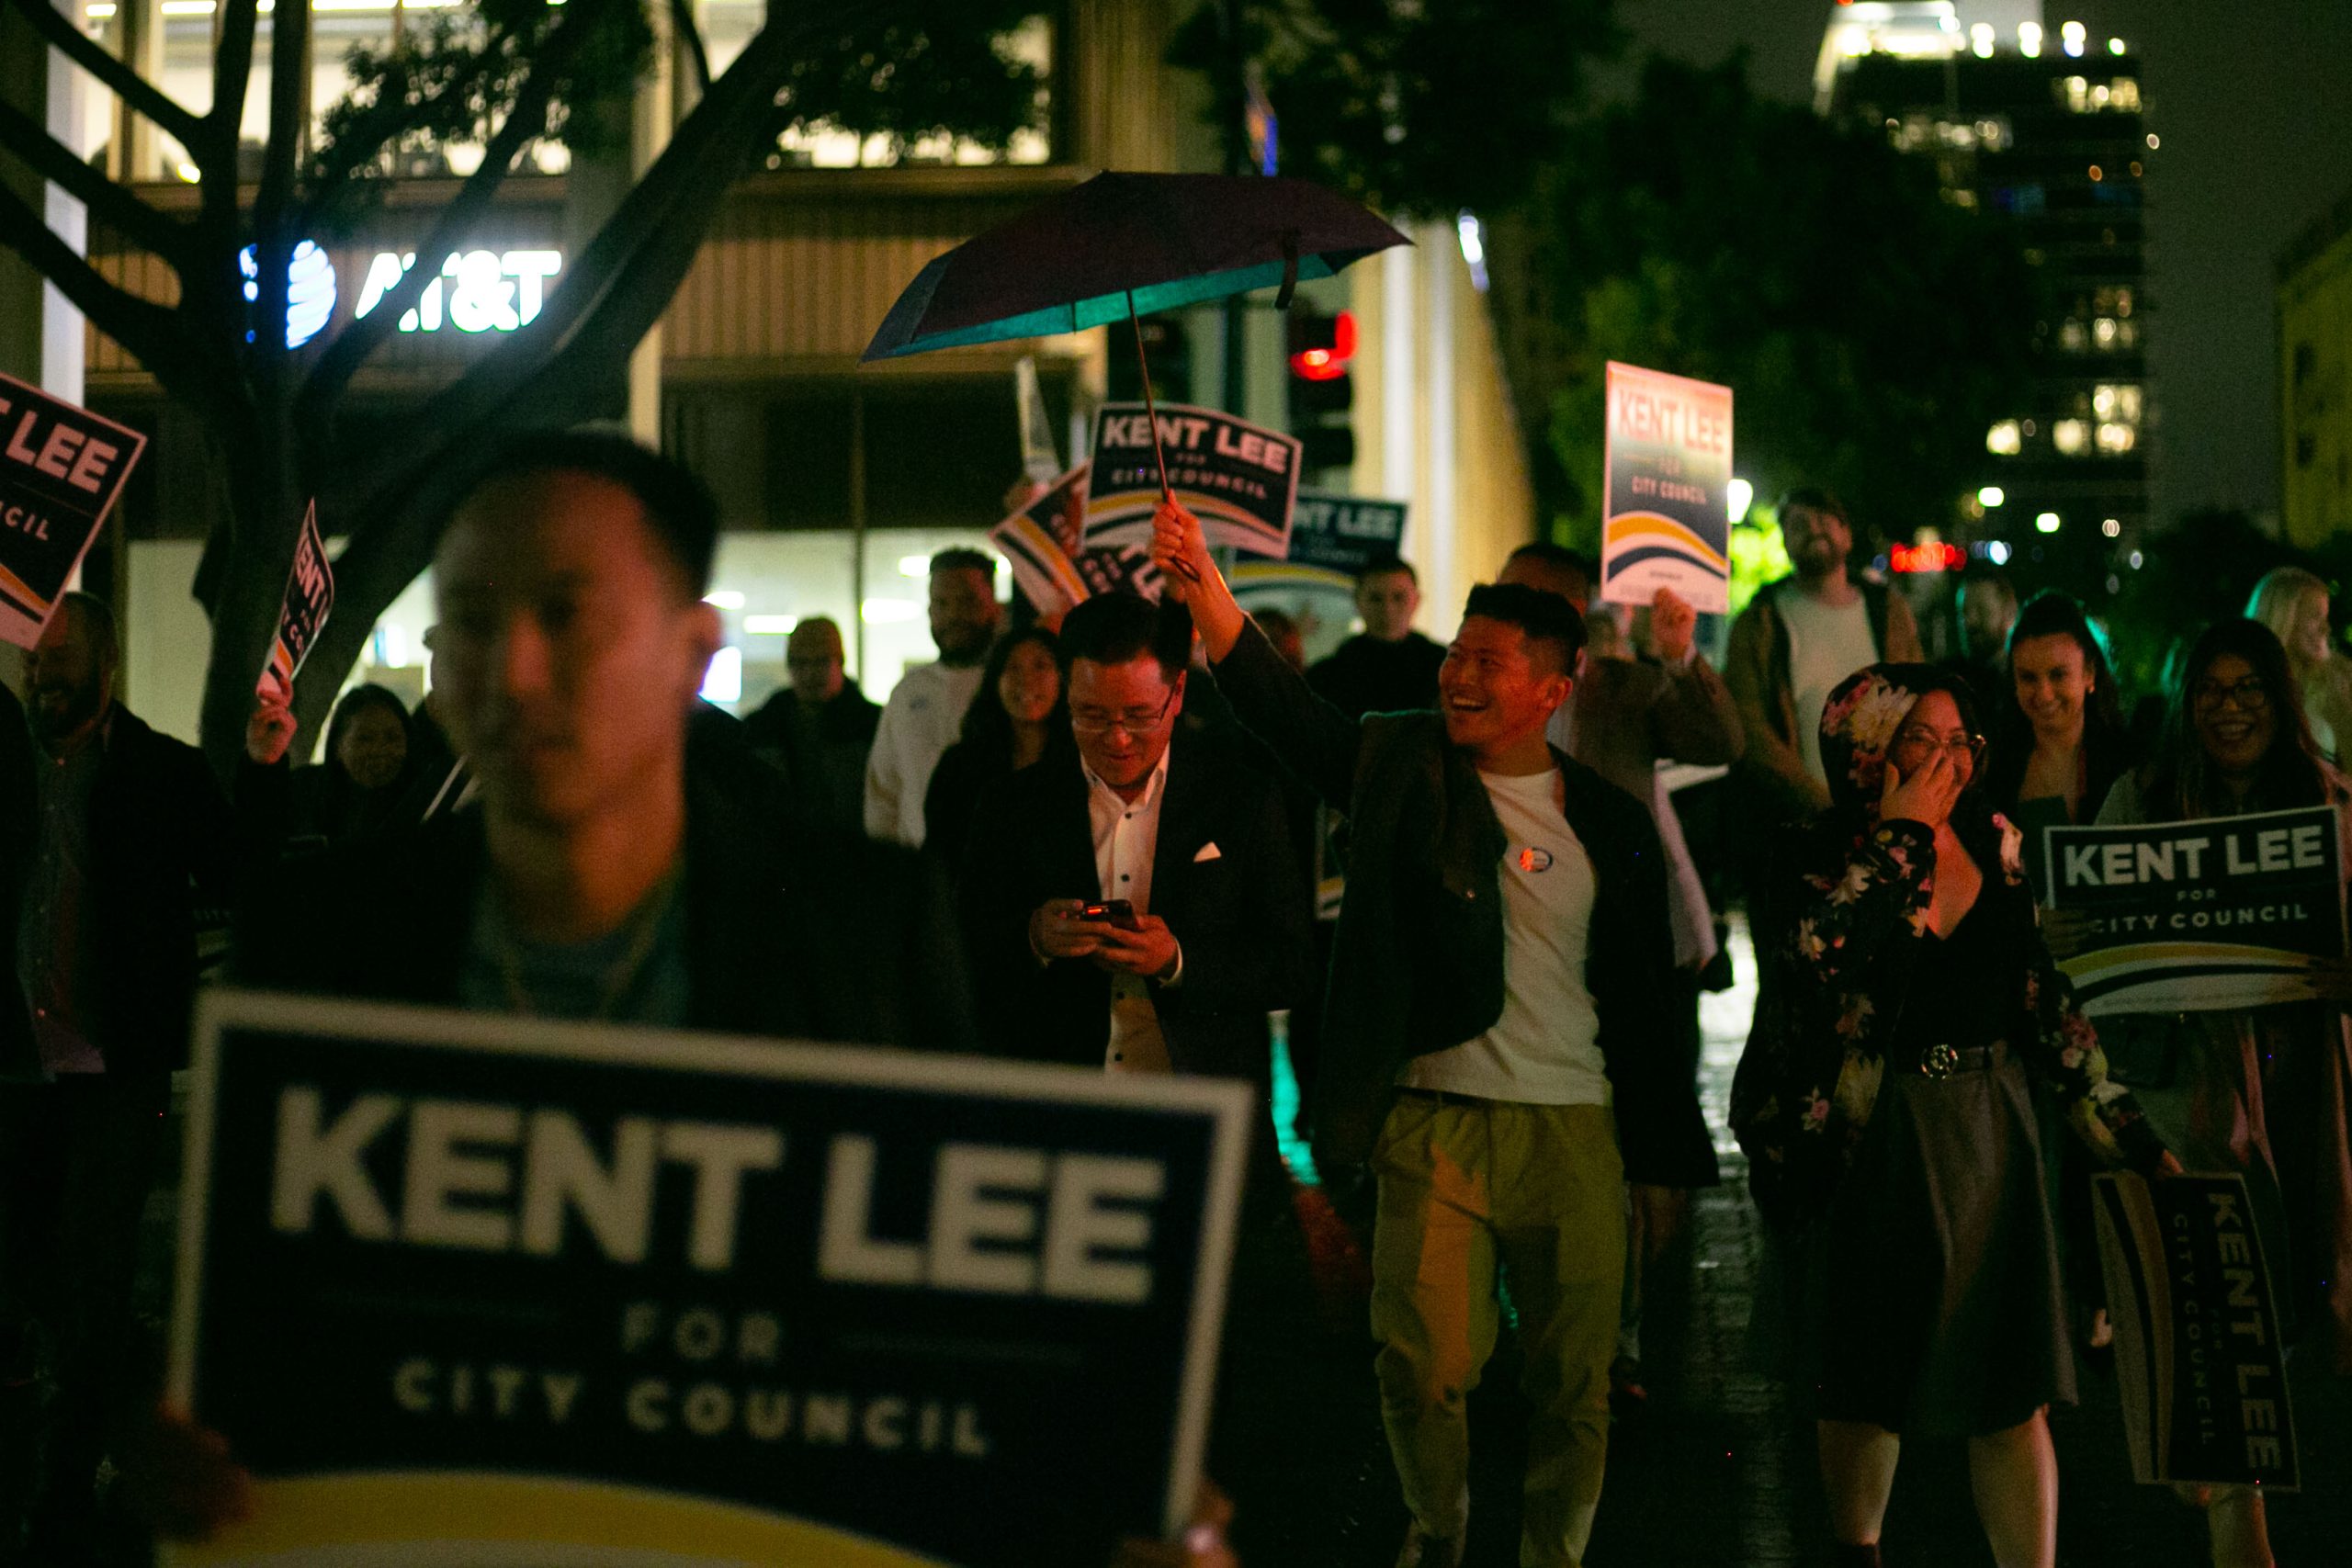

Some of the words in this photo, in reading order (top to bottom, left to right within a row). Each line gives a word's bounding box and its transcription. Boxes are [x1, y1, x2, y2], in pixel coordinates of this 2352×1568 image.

[5, 409, 119, 495] LEE
[1102, 415, 1211, 451] KENT
[1214, 423, 1289, 475] LEE
[1619, 388, 1679, 446] KENT
[1683, 402, 1724, 454] LEE
[1631, 475, 1657, 495] CITY
[1659, 479, 1707, 504] COUNCIL
[2063, 837, 2211, 887] KENT
[2224, 825, 2326, 876] LEE
[2168, 903, 2309, 930] COUNCIL
[2176, 887, 2217, 902] FOR
[270, 1084, 786, 1273] KENT
[815, 1133, 1170, 1305] LEE
[2172, 1212, 2197, 1287] CITY
[2208, 1193, 2266, 1347] KENT
[617, 1303, 784, 1364] FOR
[2182, 1300, 2217, 1445] COUNCIL
[391, 1358, 584, 1424] CITY
[624, 1379, 990, 1460] COUNCIL
[2235, 1363, 2281, 1470] LEE
